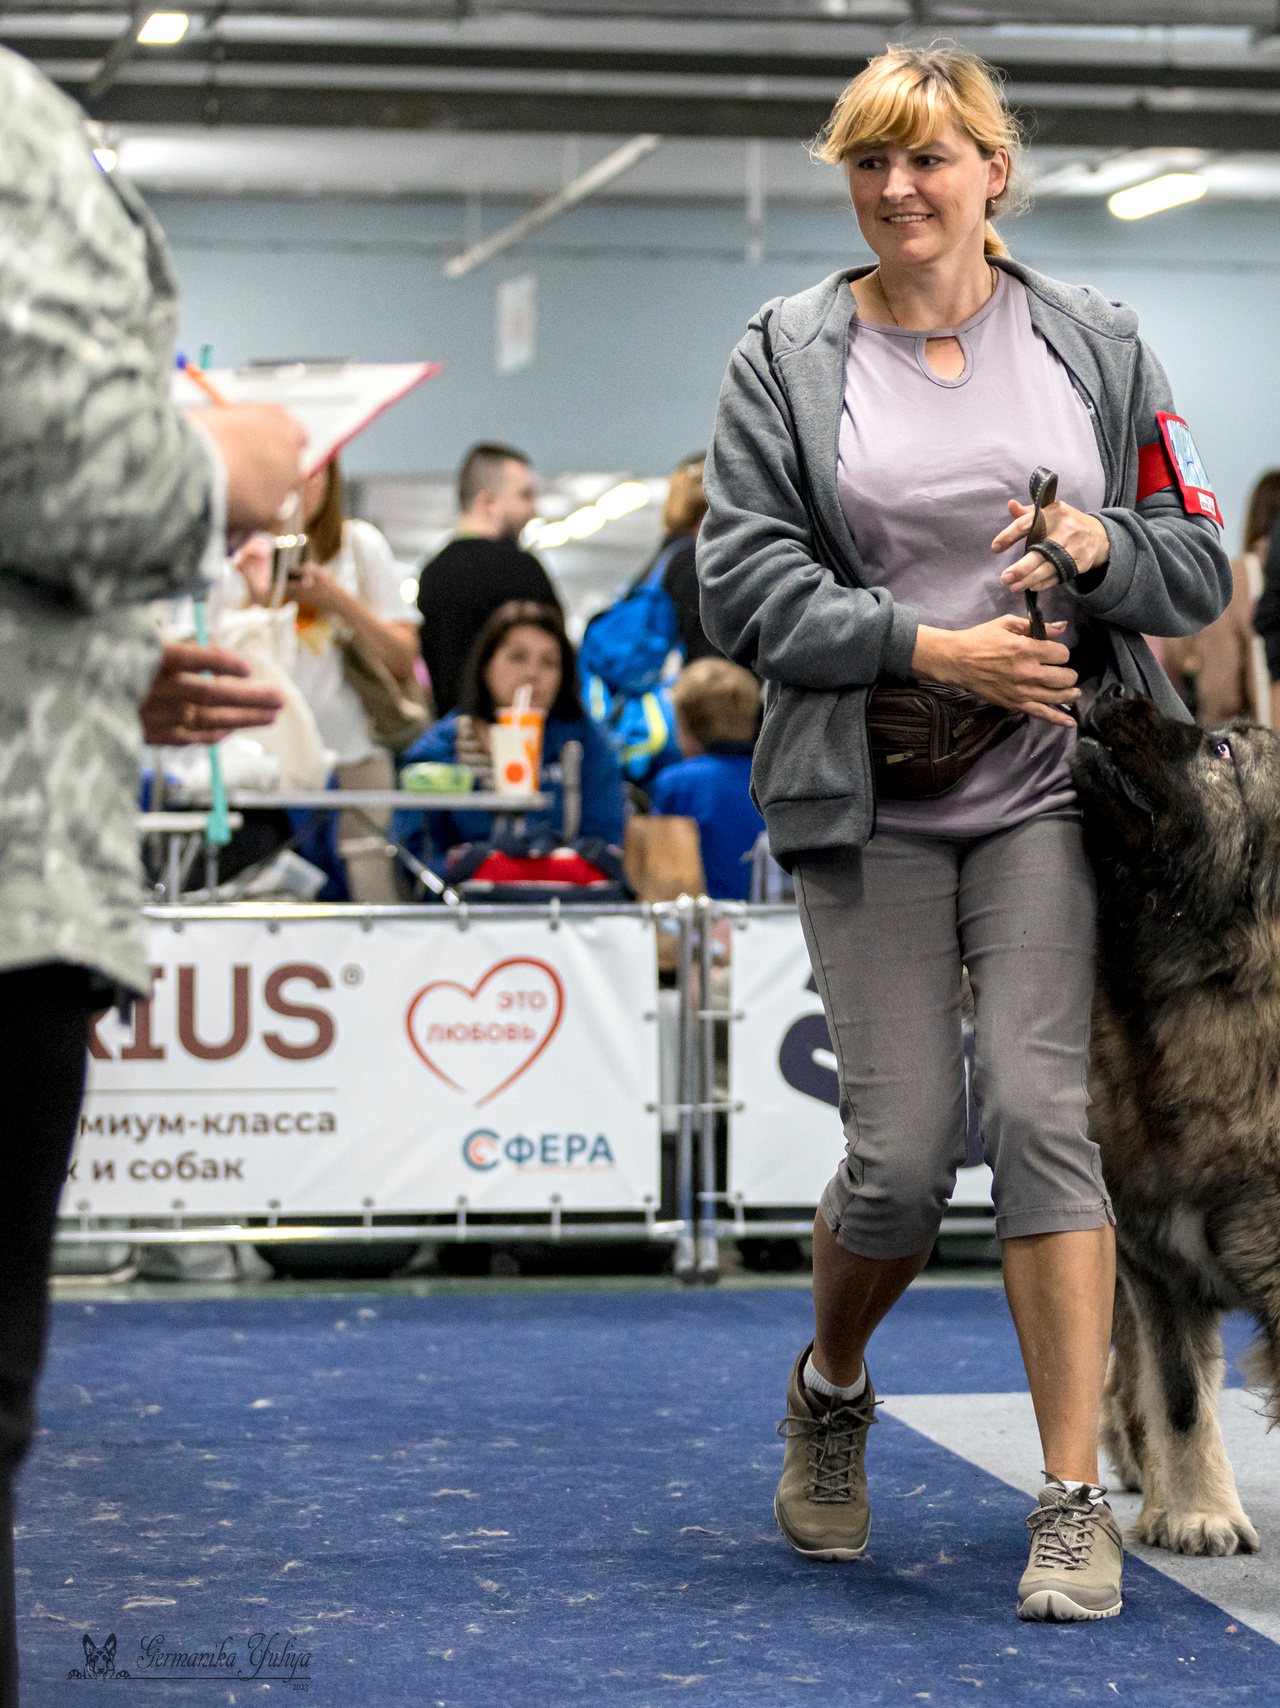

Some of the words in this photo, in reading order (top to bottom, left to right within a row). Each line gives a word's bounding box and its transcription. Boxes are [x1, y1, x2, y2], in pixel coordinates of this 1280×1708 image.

[498, 990, 547, 1010] ЭТО
[427, 1022, 537, 1043] ЛЮБОВЬ
[80, 1112, 337, 1143] миум-класса
[462, 1127, 615, 1172] СФЕРА
[93, 1160, 116, 1180] и
[128, 1151, 245, 1181] собак
